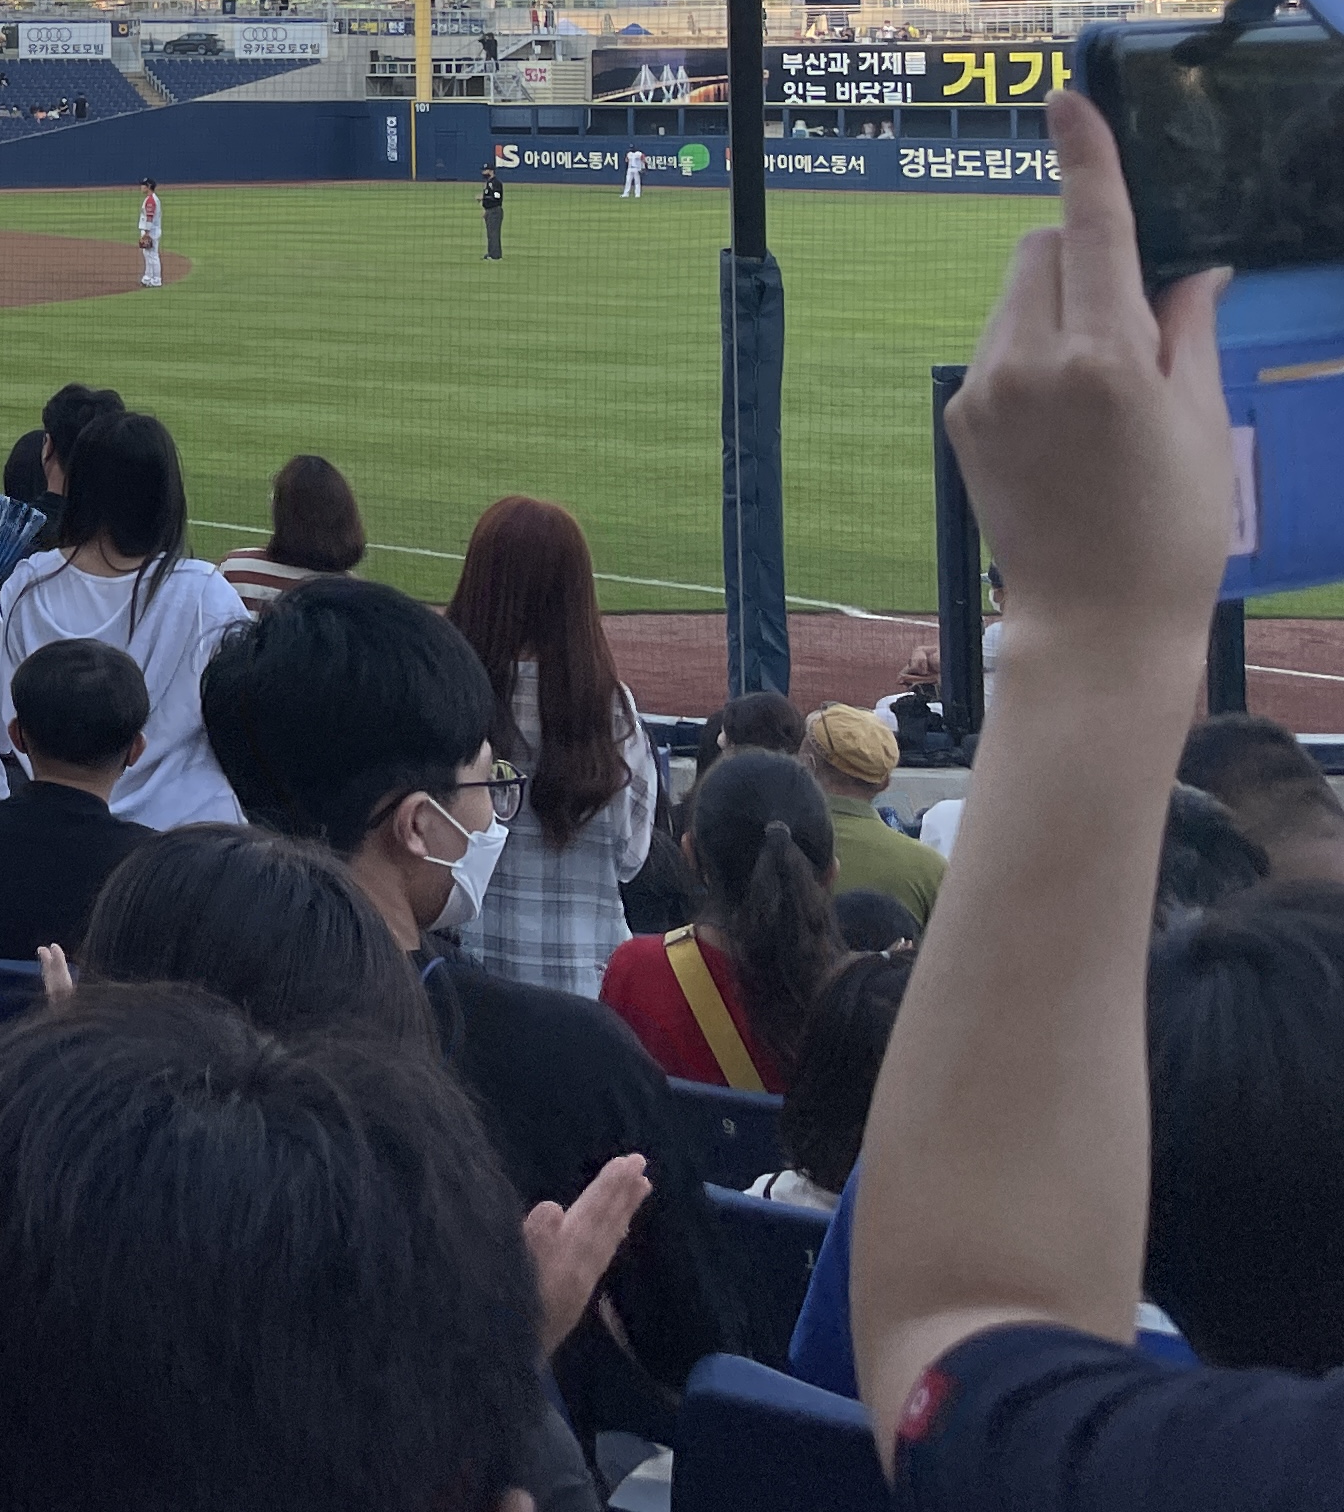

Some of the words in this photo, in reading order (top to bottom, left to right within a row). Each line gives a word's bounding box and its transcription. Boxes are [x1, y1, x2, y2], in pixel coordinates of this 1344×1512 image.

[27, 43, 103, 55] 유카로오토모빌
[243, 42, 320, 55] 유카로오토모빌
[782, 53, 849, 76] 부산과
[858, 52, 926, 75] 거제를
[525, 68, 547, 82] 5GX
[836, 82, 912, 104] 바닷길!
[415, 103, 430, 113] 101
[524, 150, 619, 170] 아이에스동서
[722, 1118, 735, 1134] 9
